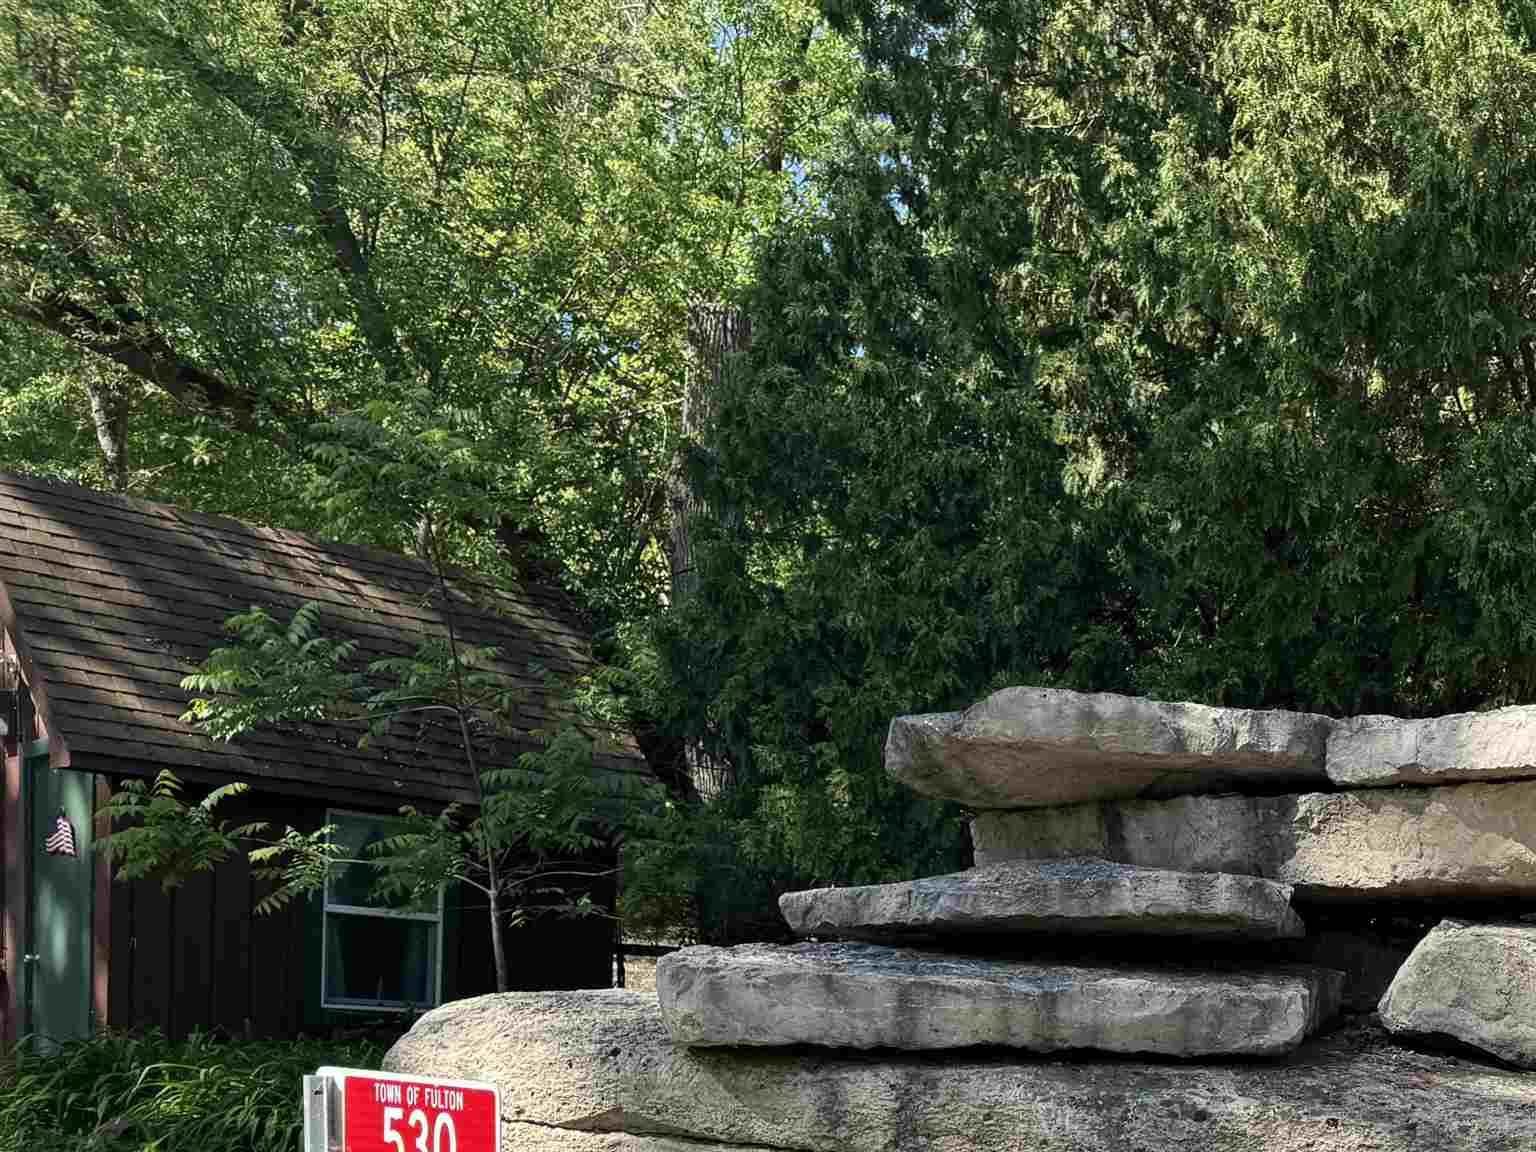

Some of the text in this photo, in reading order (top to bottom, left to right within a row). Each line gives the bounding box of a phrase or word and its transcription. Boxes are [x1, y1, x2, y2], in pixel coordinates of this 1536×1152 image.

[374, 1083, 464, 1111] TOWN OF FULTON
